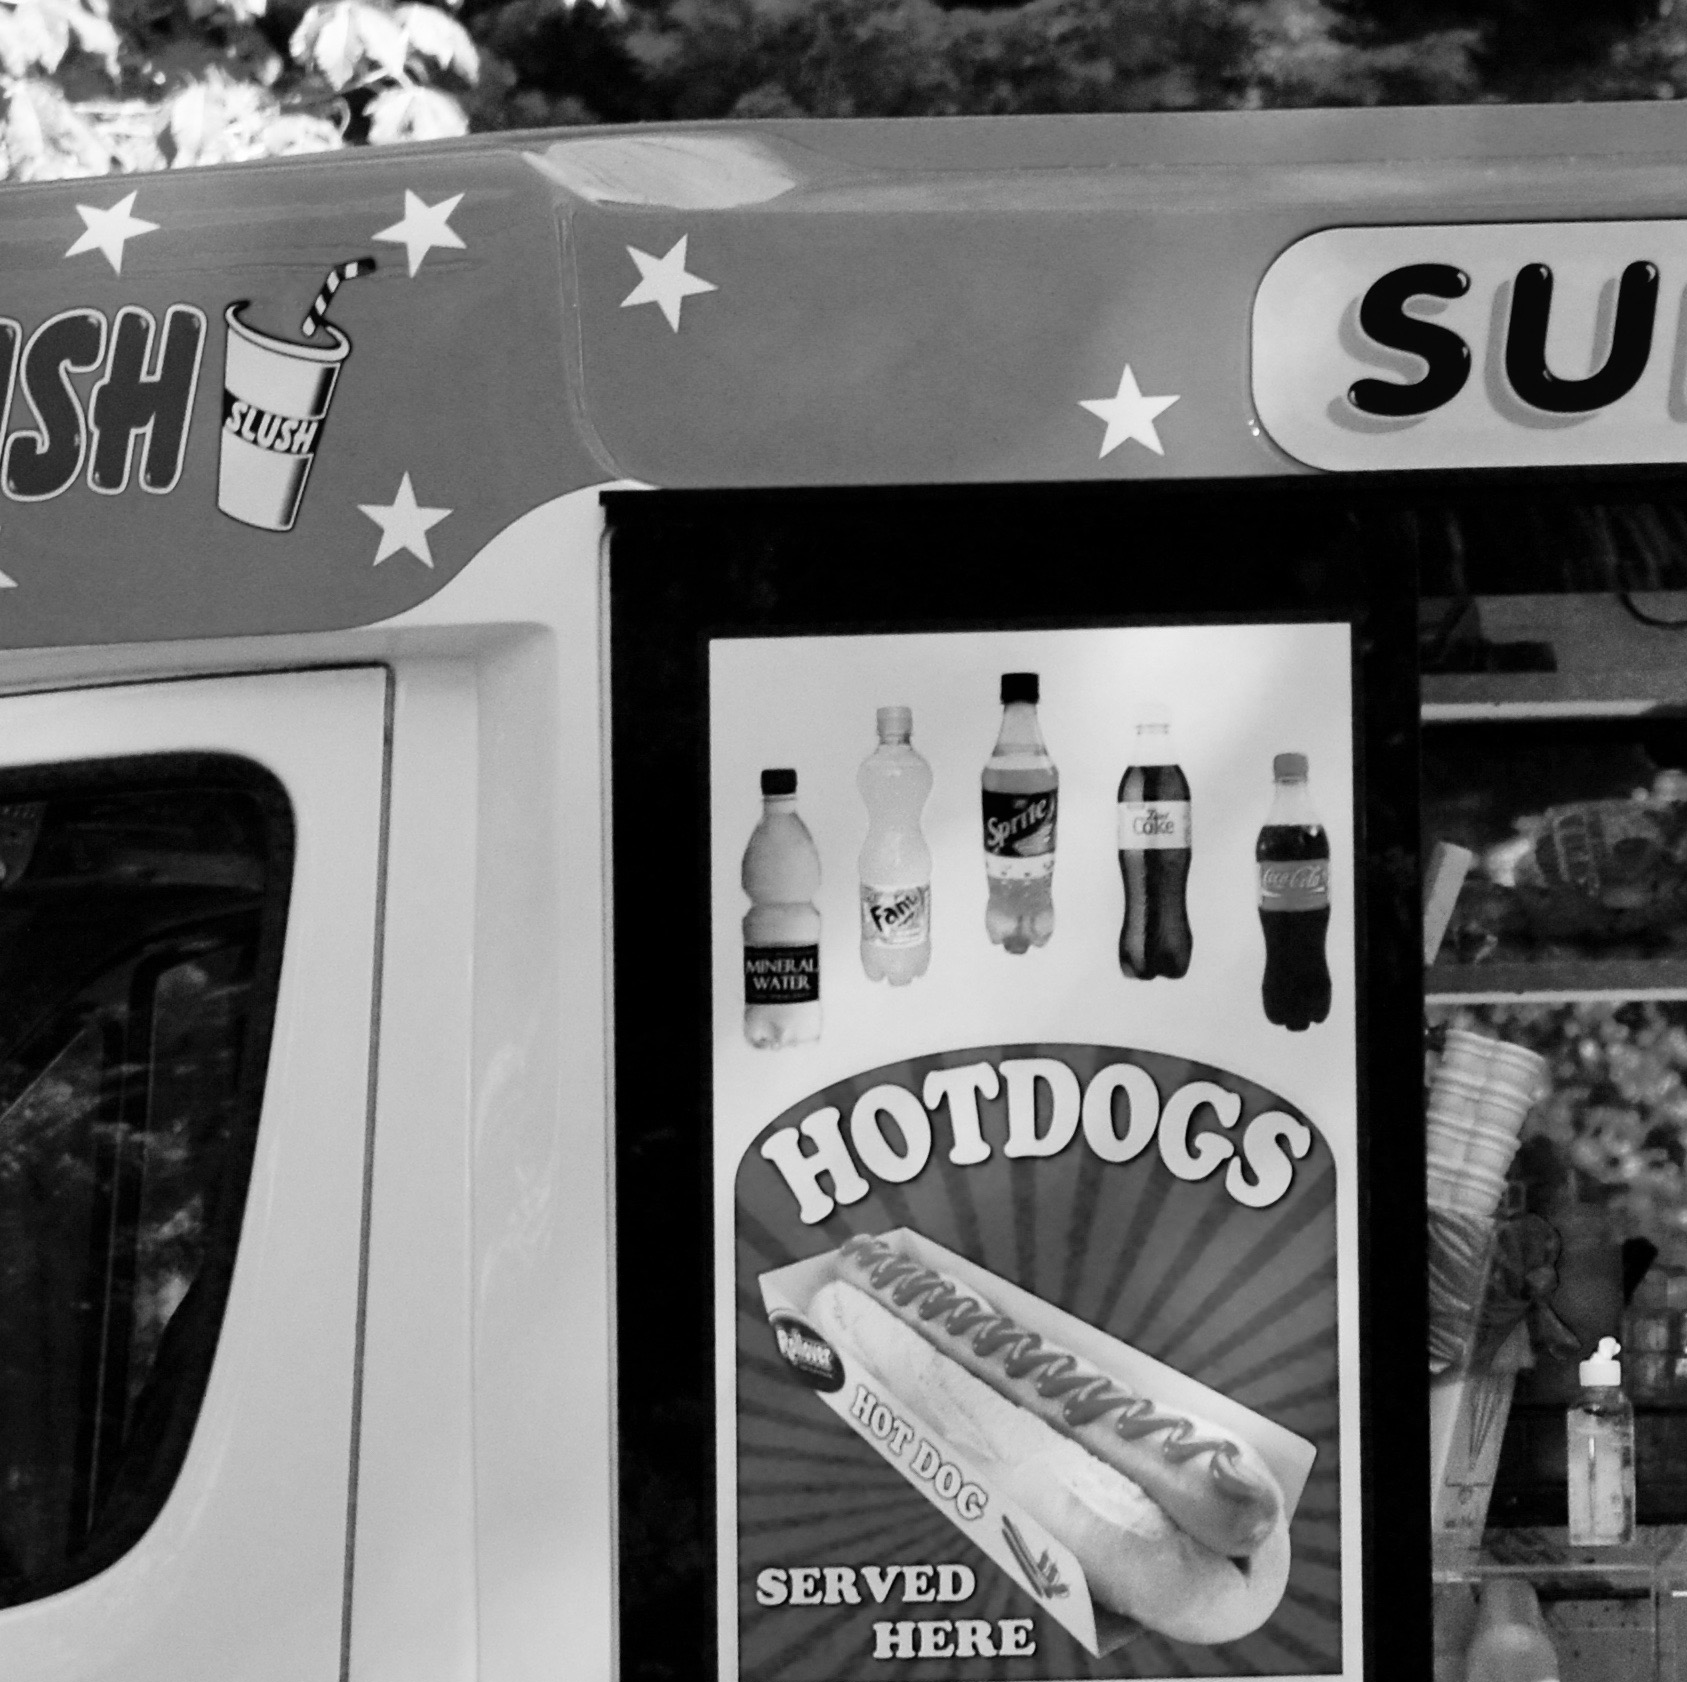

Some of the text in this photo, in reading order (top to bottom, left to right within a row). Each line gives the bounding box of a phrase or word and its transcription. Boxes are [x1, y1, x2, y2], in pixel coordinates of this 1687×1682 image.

[0, 303, 208, 502] SH
[224, 401, 319, 454] SLUSH
[986, 797, 1048, 849] Sprite
[1133, 816, 1175, 836] Coke
[745, 957, 819, 975] MINERAL
[752, 974, 812, 992] WATER
[849, 1383, 990, 1522] HOT DOG
[754, 1563, 977, 1606] SERVED
[871, 1618, 1037, 1660] HERE
